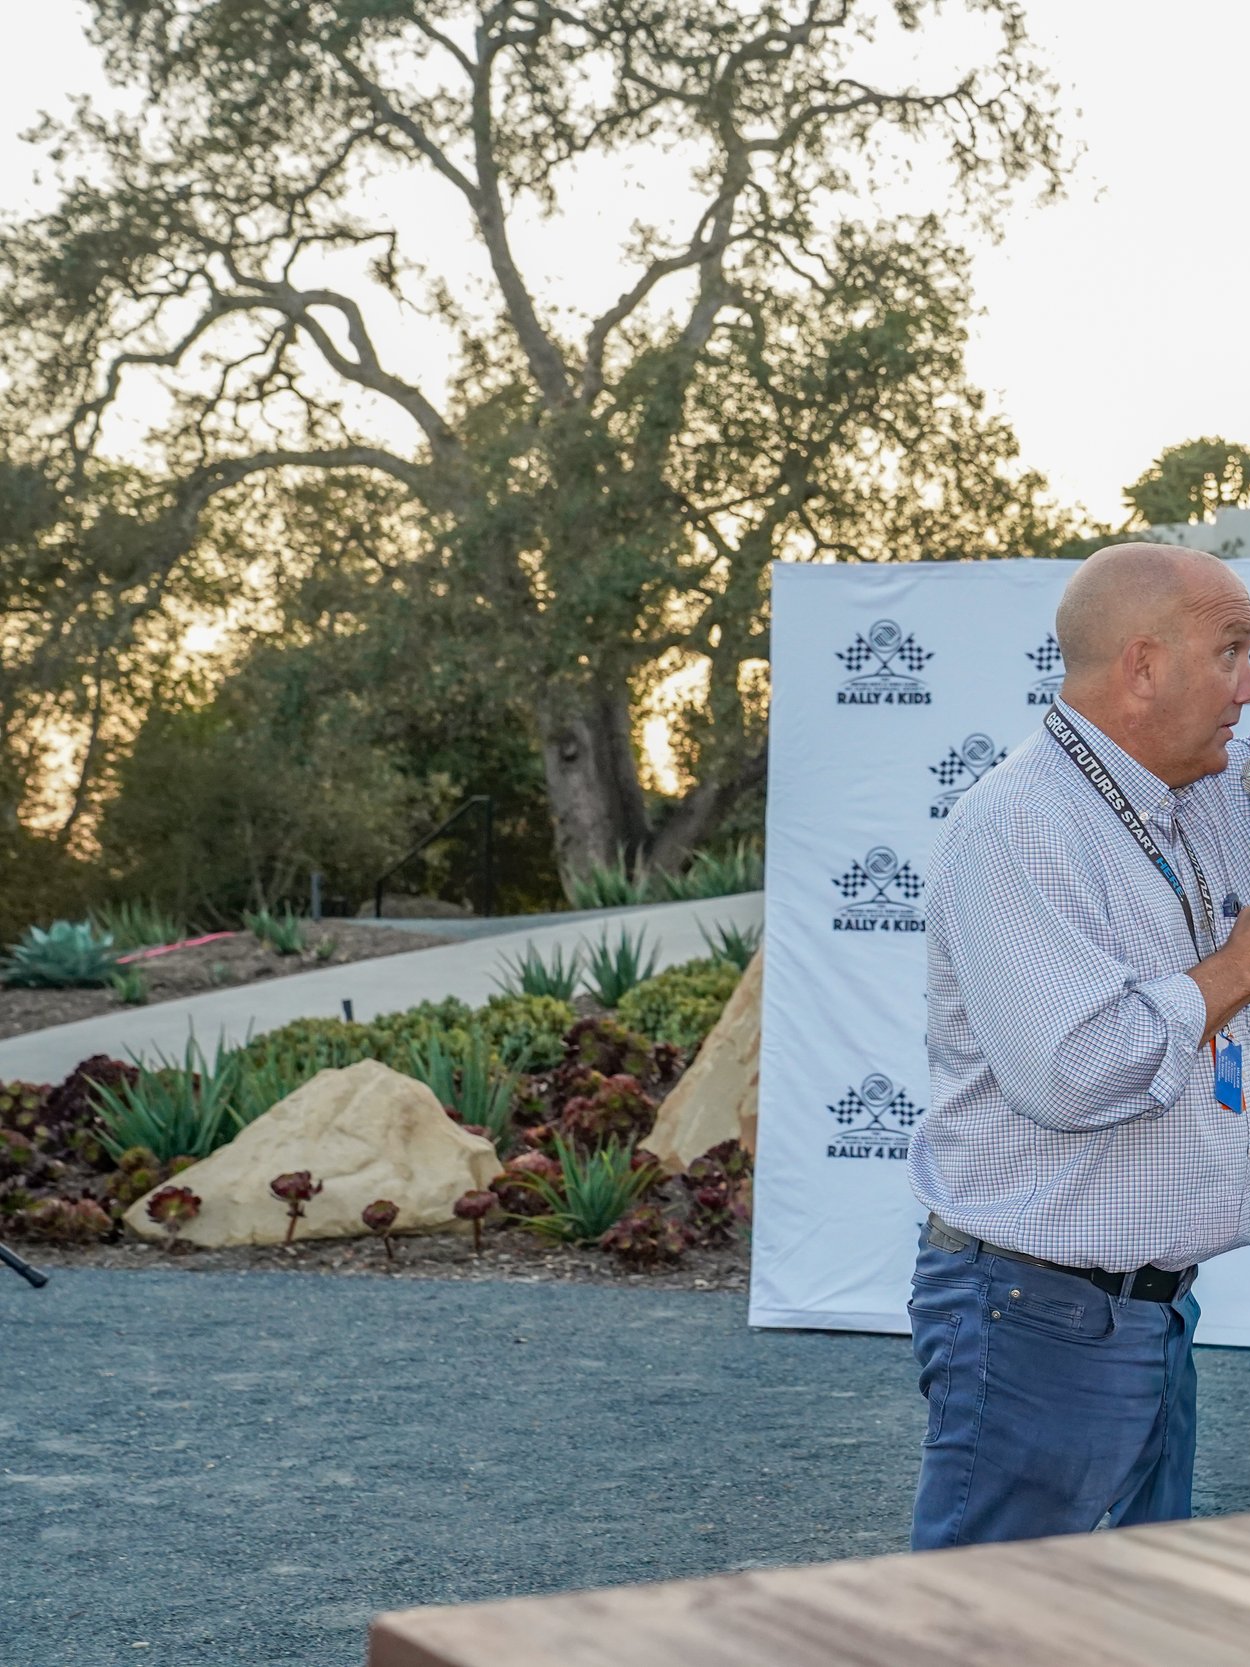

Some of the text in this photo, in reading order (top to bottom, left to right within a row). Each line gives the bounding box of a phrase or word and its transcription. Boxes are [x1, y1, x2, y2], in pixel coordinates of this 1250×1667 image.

[836, 692, 932, 705] RALLY 4 KIDS
[1027, 692, 1054, 705] RAL
[1046, 711, 1079, 745] GREAT
[1069, 743, 1125, 811] FUTURES
[1121, 810, 1159, 856] START
[1155, 856, 1185, 901] HERE.
[832, 918, 926, 932] RALLY 4 KIDS
[827, 1145, 908, 1160] RALLY 4 KI
